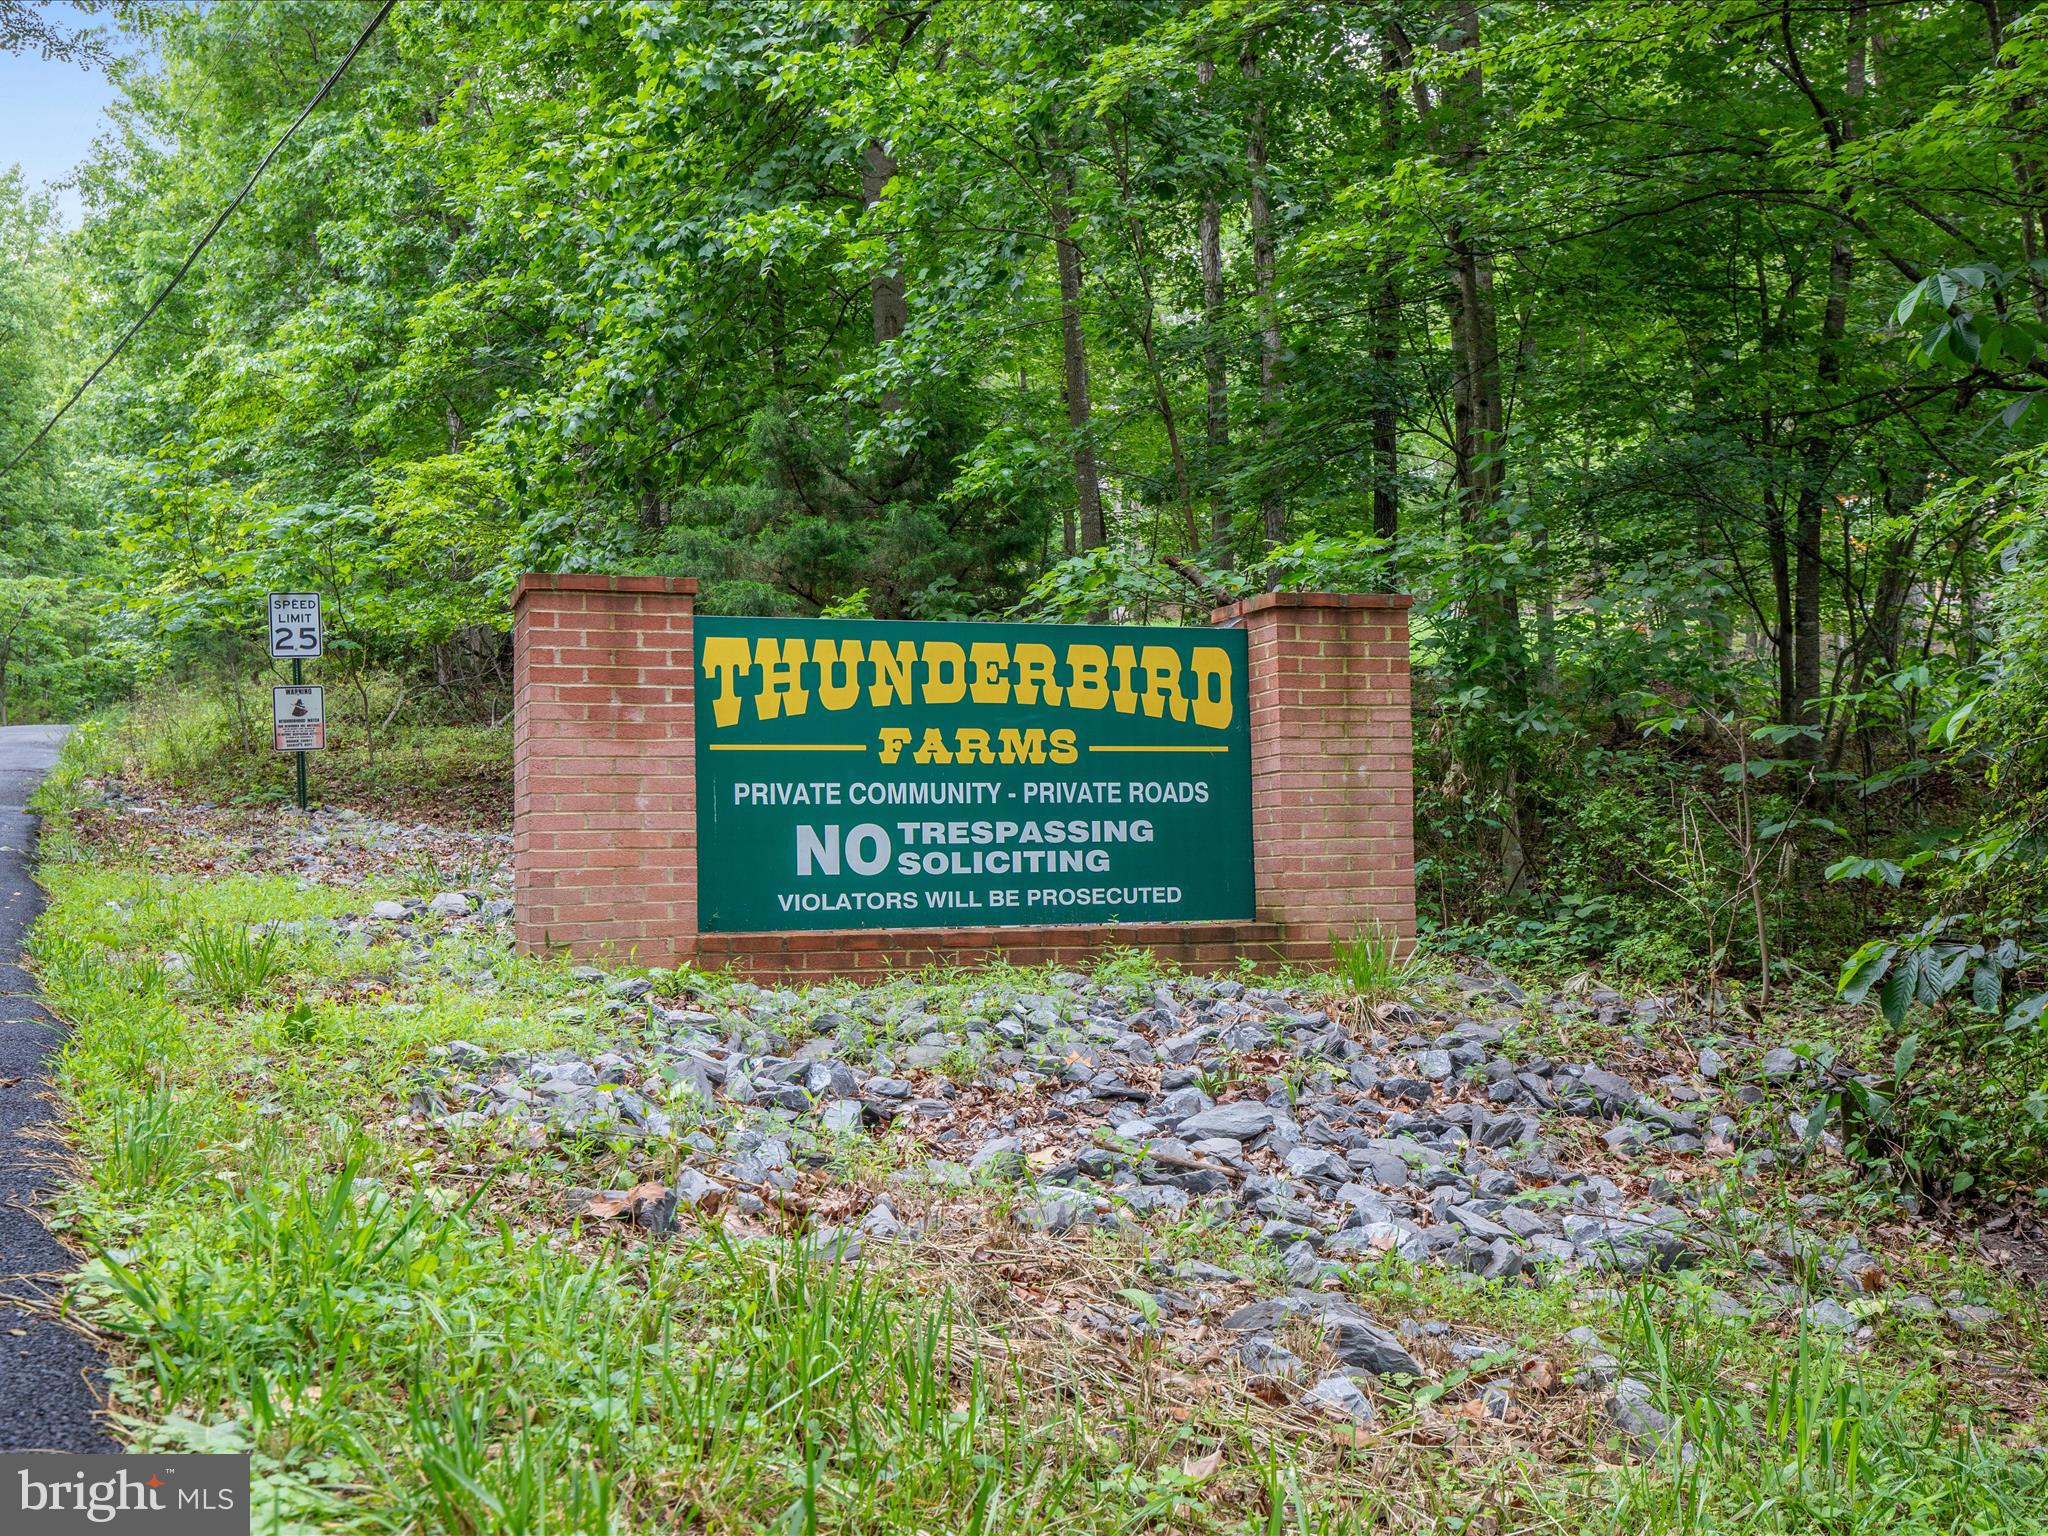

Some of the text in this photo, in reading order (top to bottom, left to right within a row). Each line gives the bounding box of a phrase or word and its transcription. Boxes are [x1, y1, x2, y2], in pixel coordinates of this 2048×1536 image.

[274, 600, 316, 609] SPEED
[278, 613, 312, 623] LIMIT
[275, 627, 318, 650] 25
[702, 637, 1233, 730] THUNDERBIRD
[878, 728, 1078, 764] FARMS
[734, 783, 841, 805] PRIVATE
[849, 783, 1001, 804] COMMUNITY
[1024, 783, 1121, 803] PRIVATE
[1129, 782, 1209, 803] ROADS
[898, 820, 1154, 844] TRESPASSING
[797, 824, 891, 876] NO
[898, 850, 1110, 875] SOLICITING
[778, 887, 1182, 911] VIOLATORS WILL BE PROSECUTED
